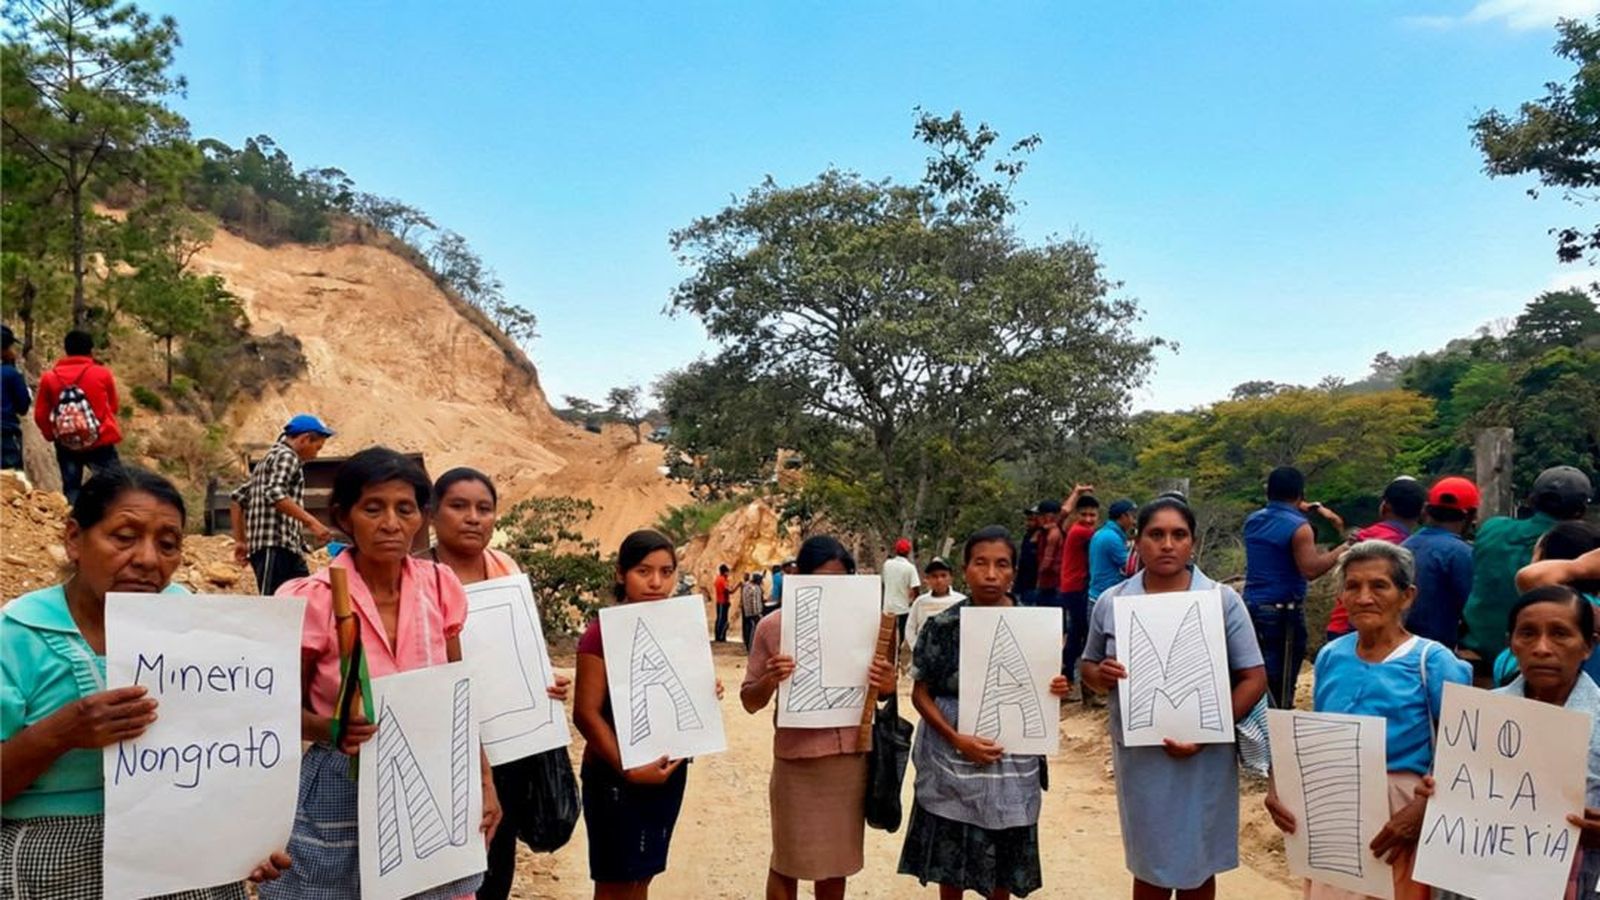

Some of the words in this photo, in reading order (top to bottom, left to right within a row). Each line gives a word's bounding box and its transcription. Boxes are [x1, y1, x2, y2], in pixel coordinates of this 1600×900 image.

[134, 653, 274, 695] Mineria
[630, 617, 704, 746] A
[786, 586, 866, 713] L
[974, 614, 1047, 741] A
[1128, 601, 1224, 732] M
[376, 678, 470, 877] N
[1444, 709, 1522, 759] NO
